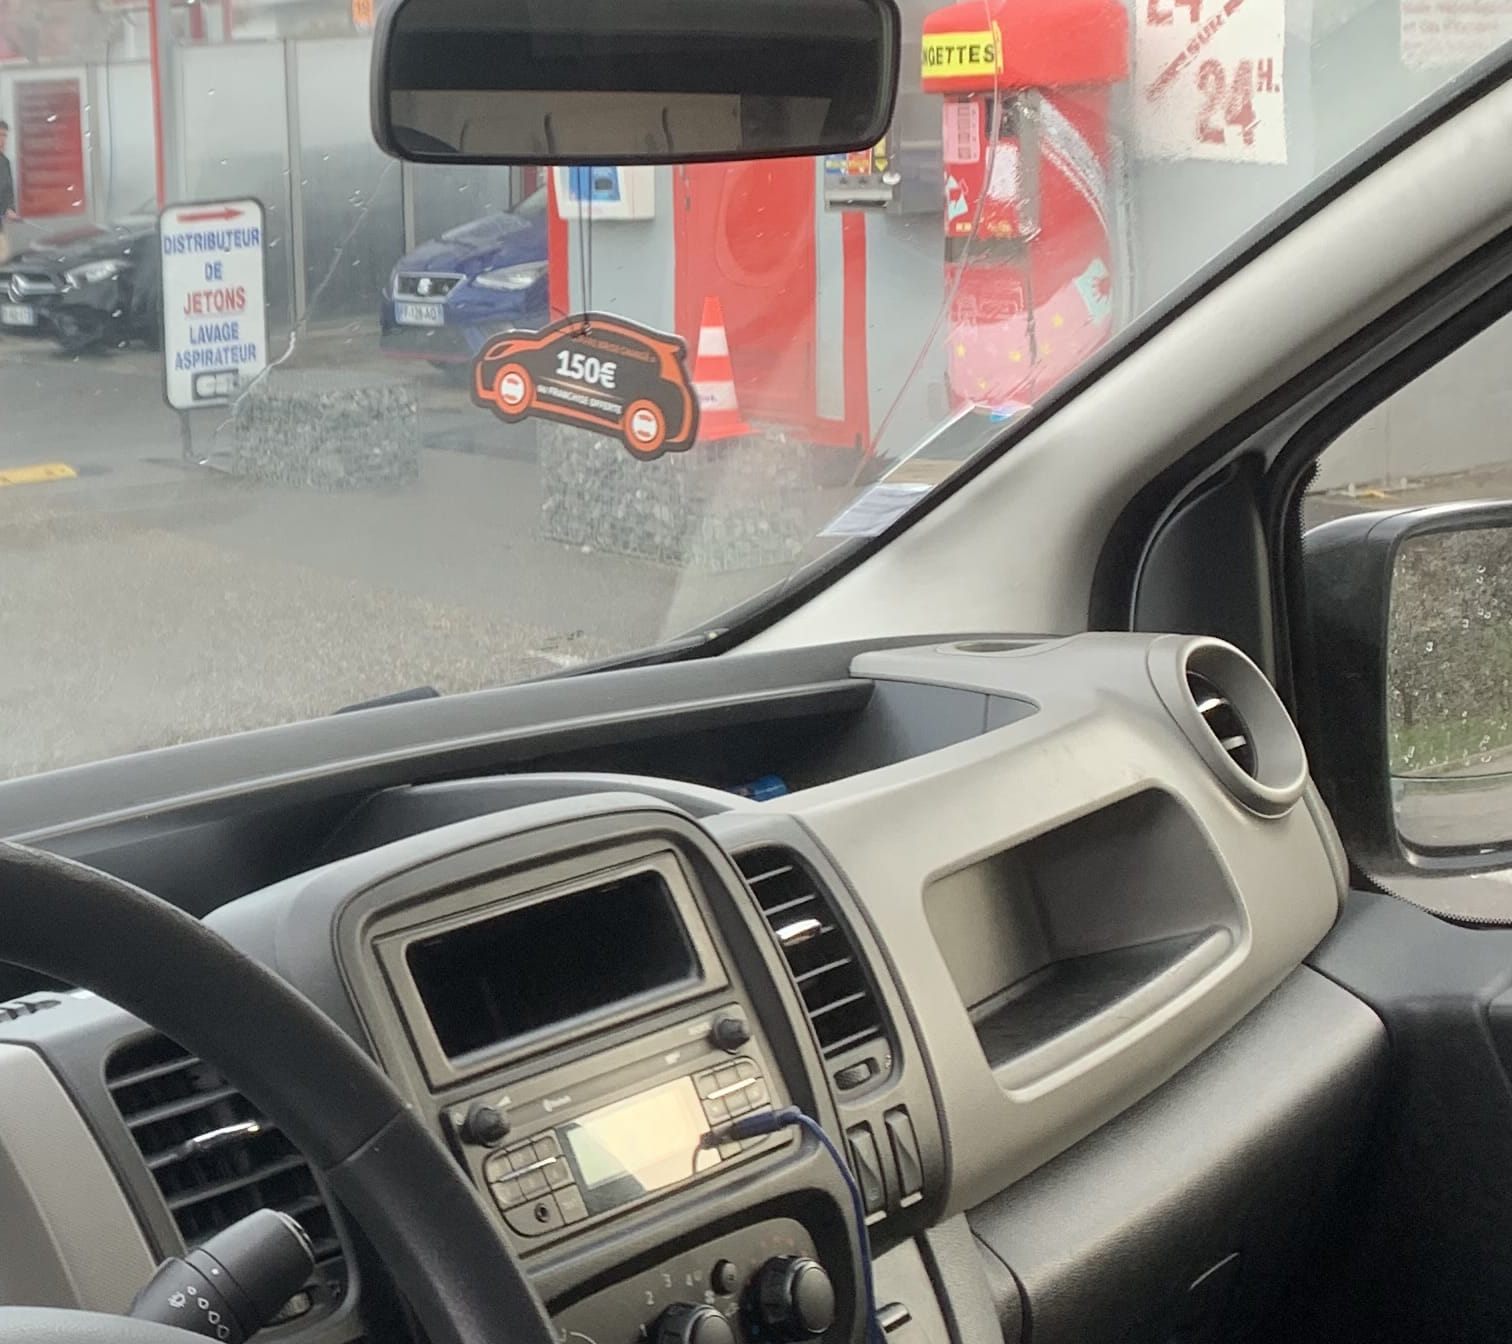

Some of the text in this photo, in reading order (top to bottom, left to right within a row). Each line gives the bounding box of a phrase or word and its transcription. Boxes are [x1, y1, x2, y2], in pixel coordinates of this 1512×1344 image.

[163, 227, 261, 255] DISTRIBUTEUR
[204, 261, 223, 281] DE
[183, 286, 246, 316] JETONS
[189, 321, 239, 345] LAVAGE
[175, 344, 256, 371] ASPIRATEUR
[556, 349, 617, 389] 150€
